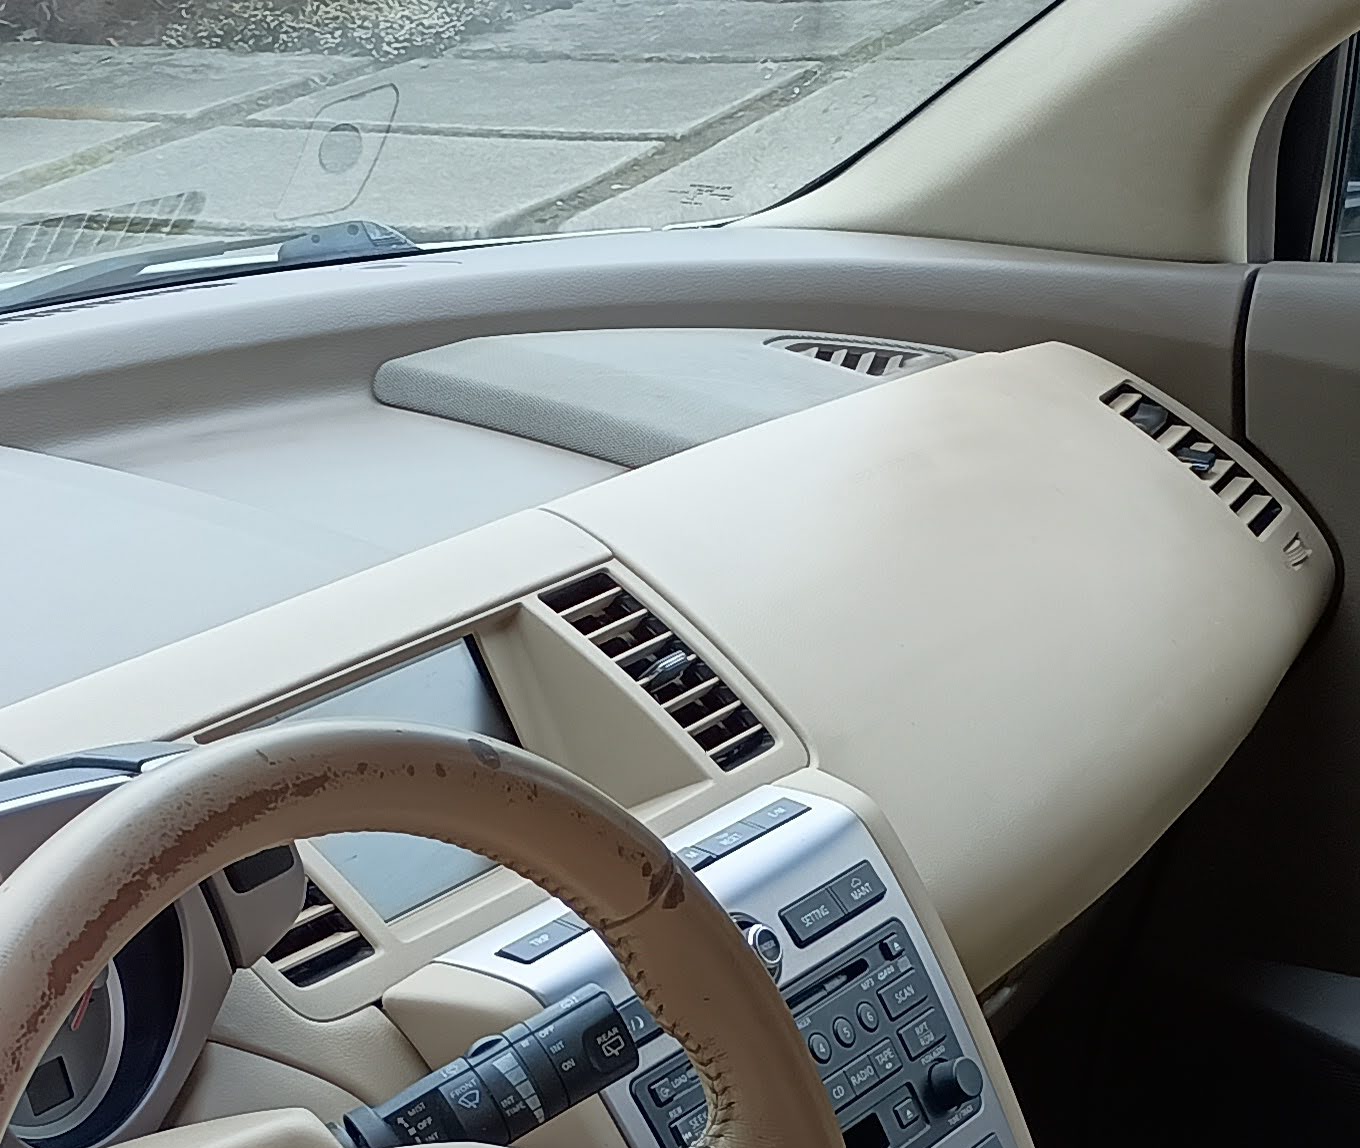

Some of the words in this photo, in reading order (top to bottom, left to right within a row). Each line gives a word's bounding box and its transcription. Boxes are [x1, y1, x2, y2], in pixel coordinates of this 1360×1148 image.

[800, 904, 831, 928] SETTING
[894, 984, 915, 1004] SCAN
[866, 1011, 874, 1022] 6
[596, 1026, 620, 1045] REAR
[842, 1027, 851, 1038] 5
[875, 1047, 895, 1065] TAPE
[561, 1058, 577, 1072] ON
[850, 1065, 875, 1087] RADIO
[450, 1078, 479, 1100] FRONT
[832, 1085, 845, 1100] CD
[407, 1102, 427, 1118] MIST
[417, 1117, 433, 1132] OFF
